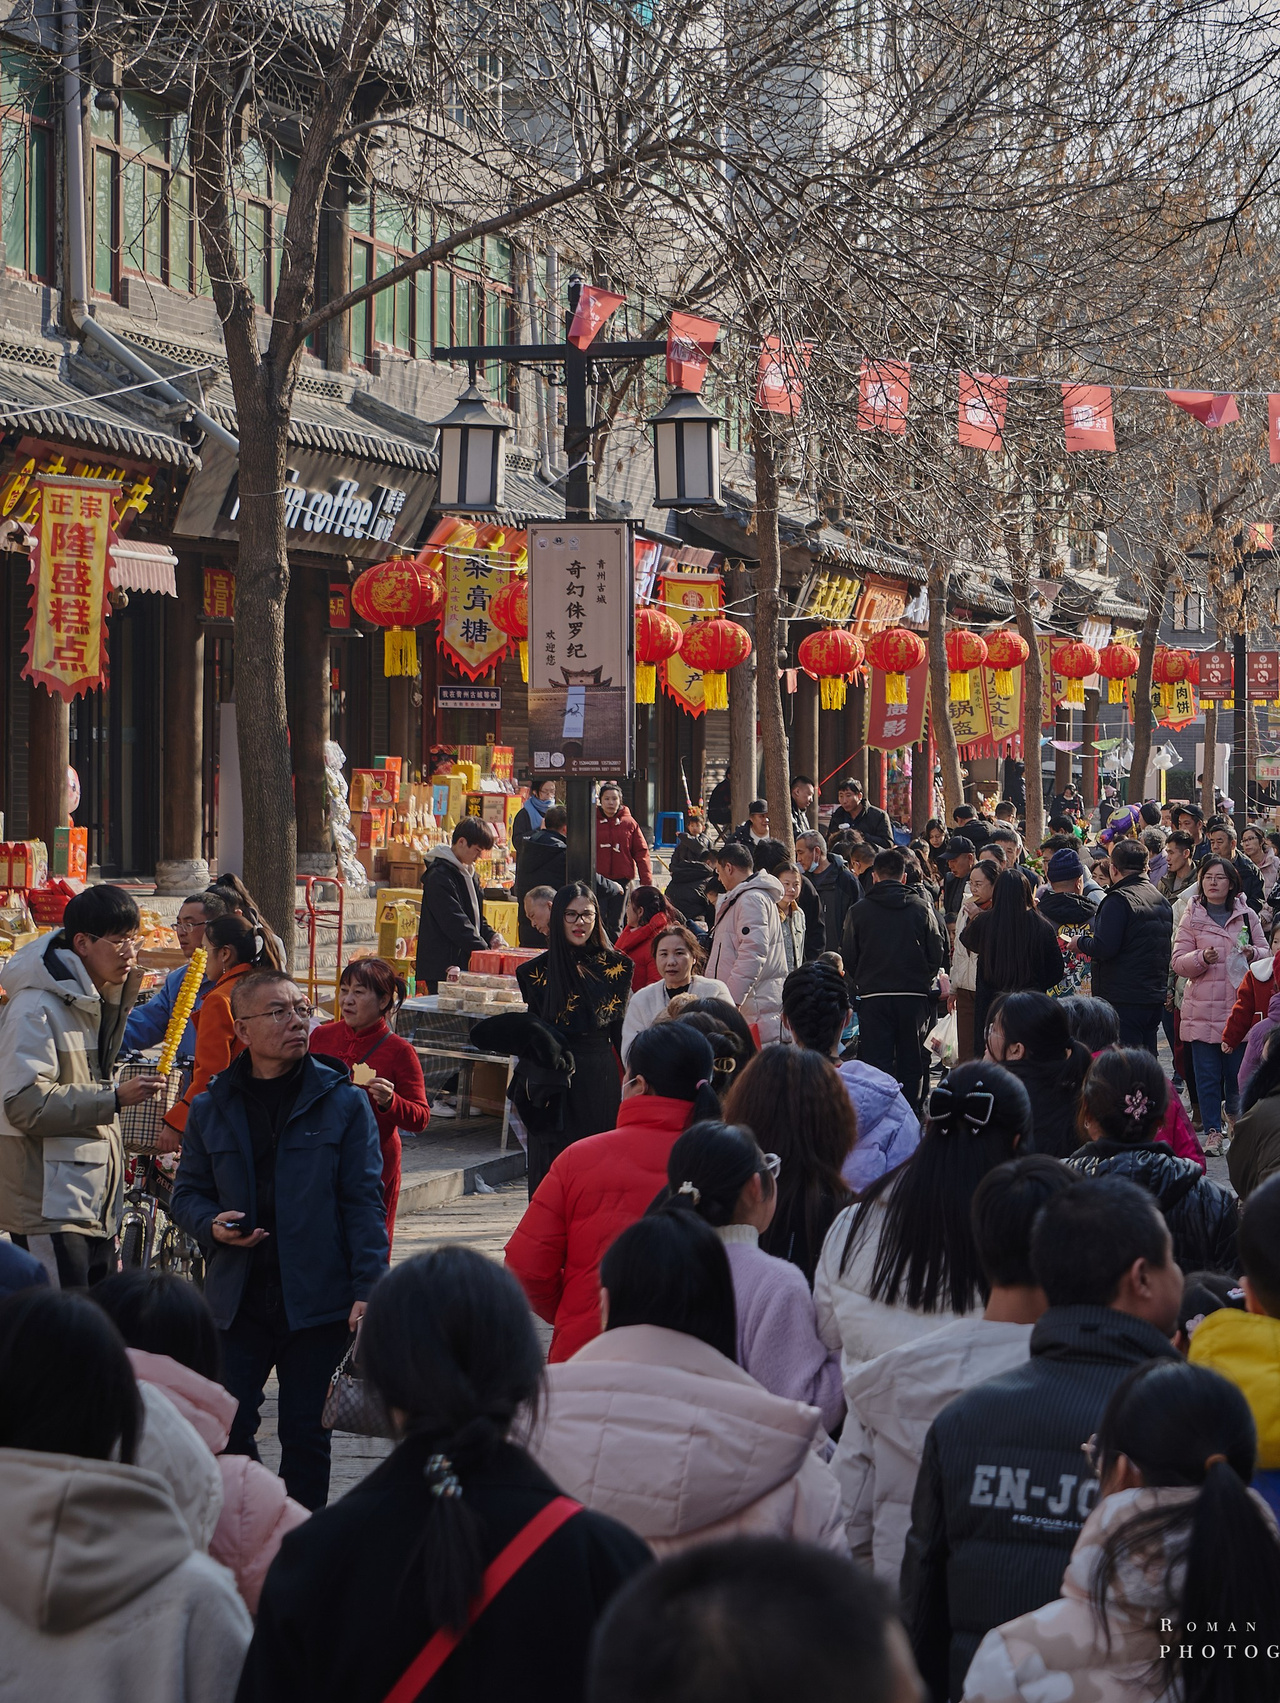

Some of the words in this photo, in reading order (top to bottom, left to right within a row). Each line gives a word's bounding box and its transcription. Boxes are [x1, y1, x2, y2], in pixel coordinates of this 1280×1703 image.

[49, 493, 102, 519] 正宗
[303, 480, 373, 539] coffee
[45, 522, 97, 674] 隆盛糕点
[460, 553, 494, 643] 梨膏糖
[596, 559, 607, 604] 青州古城
[565, 560, 587, 659] 奇幻侏罗纪
[545, 629, 556, 666] 欢迎您
[810, 642, 828, 663] 財
[442, 690, 497, 700] 我在青州古城等你
[949, 688, 978, 736] 锅盔
[972, 674, 983, 709] 中国名小吃
